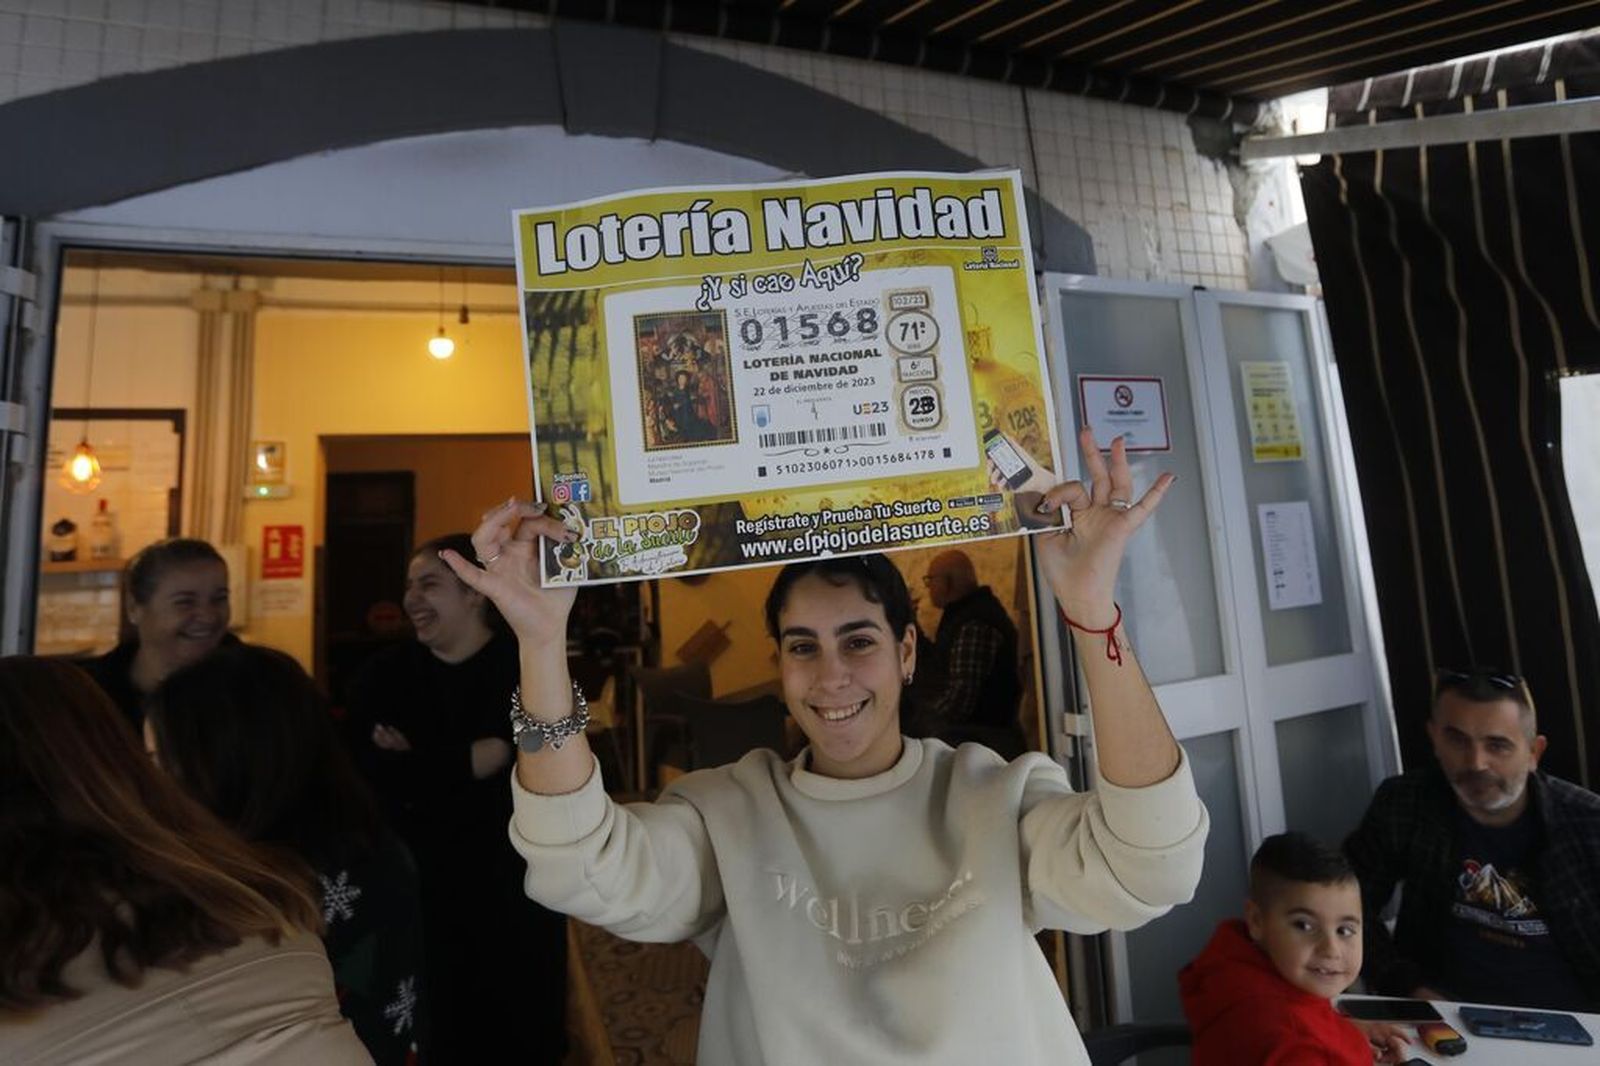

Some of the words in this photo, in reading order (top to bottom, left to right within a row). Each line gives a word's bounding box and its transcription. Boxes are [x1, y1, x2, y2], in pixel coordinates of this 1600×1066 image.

[534, 199, 752, 276] Lotería
[762, 187, 1006, 251] Navidad
[729, 273, 748, 299] si
[752, 272, 795, 294] cae
[800, 252, 865, 292] Aquí?
[740, 307, 879, 346] 01568
[743, 353, 804, 369] LOTERÍA
[809, 348, 882, 364] NACIONAL
[753, 387, 766, 396] 22
[768, 384, 782, 395] de
[783, 380, 833, 394] diciembre
[836, 378, 849, 389] de
[851, 377, 876, 388] 2023
[769, 371, 789, 381] DE
[793, 365, 858, 379] NAVIDAD
[776, 449, 936, 475] 5102306071>0015684178
[592, 519, 619, 539] EL
[623, 511, 698, 537] PIOJO
[811, 513, 820, 527] y
[822, 507, 872, 526] Prueba
[874, 504, 892, 519] Tu
[892, 499, 941, 517] Suerte
[740, 514, 990, 558] www.elpiojodelasuerte.es
